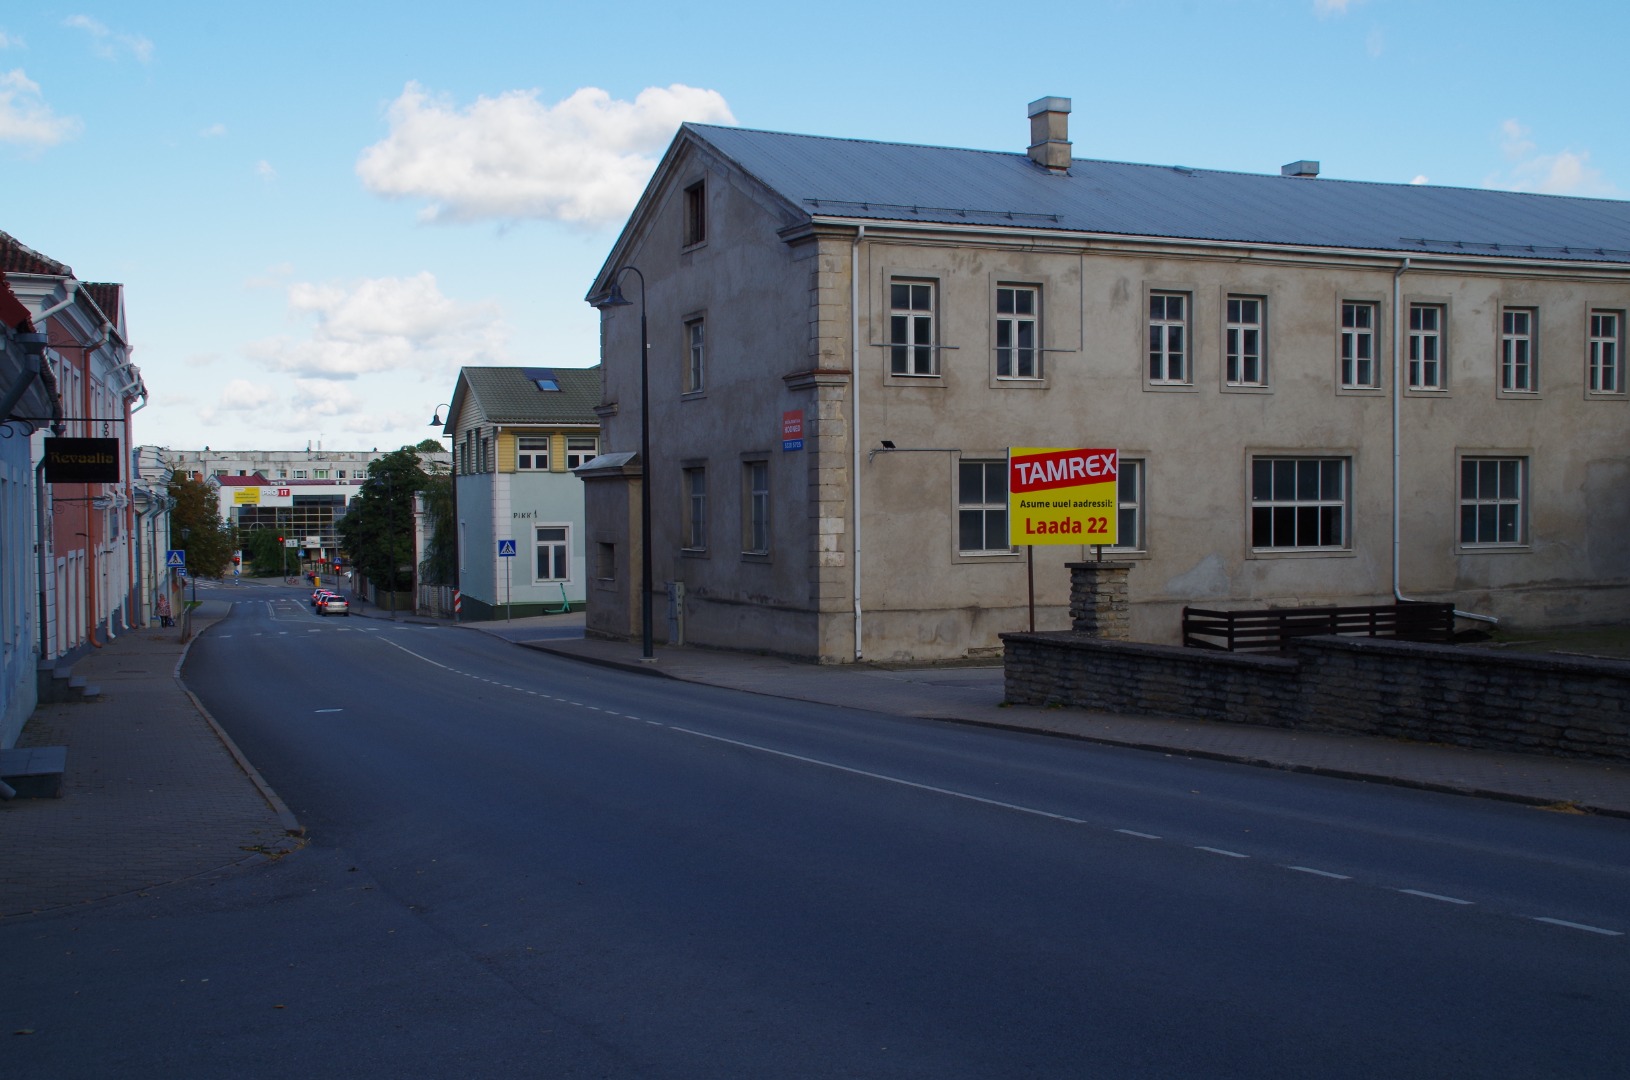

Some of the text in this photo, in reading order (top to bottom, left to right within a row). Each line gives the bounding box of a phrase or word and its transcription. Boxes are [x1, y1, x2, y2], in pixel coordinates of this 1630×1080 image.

[49, 451, 114, 464] Revaalia
[1014, 452, 1117, 485] TAMREX
[1020, 499, 1113, 508] Asume uuel aadressil:
[1025, 516, 1108, 535] Laada 22
